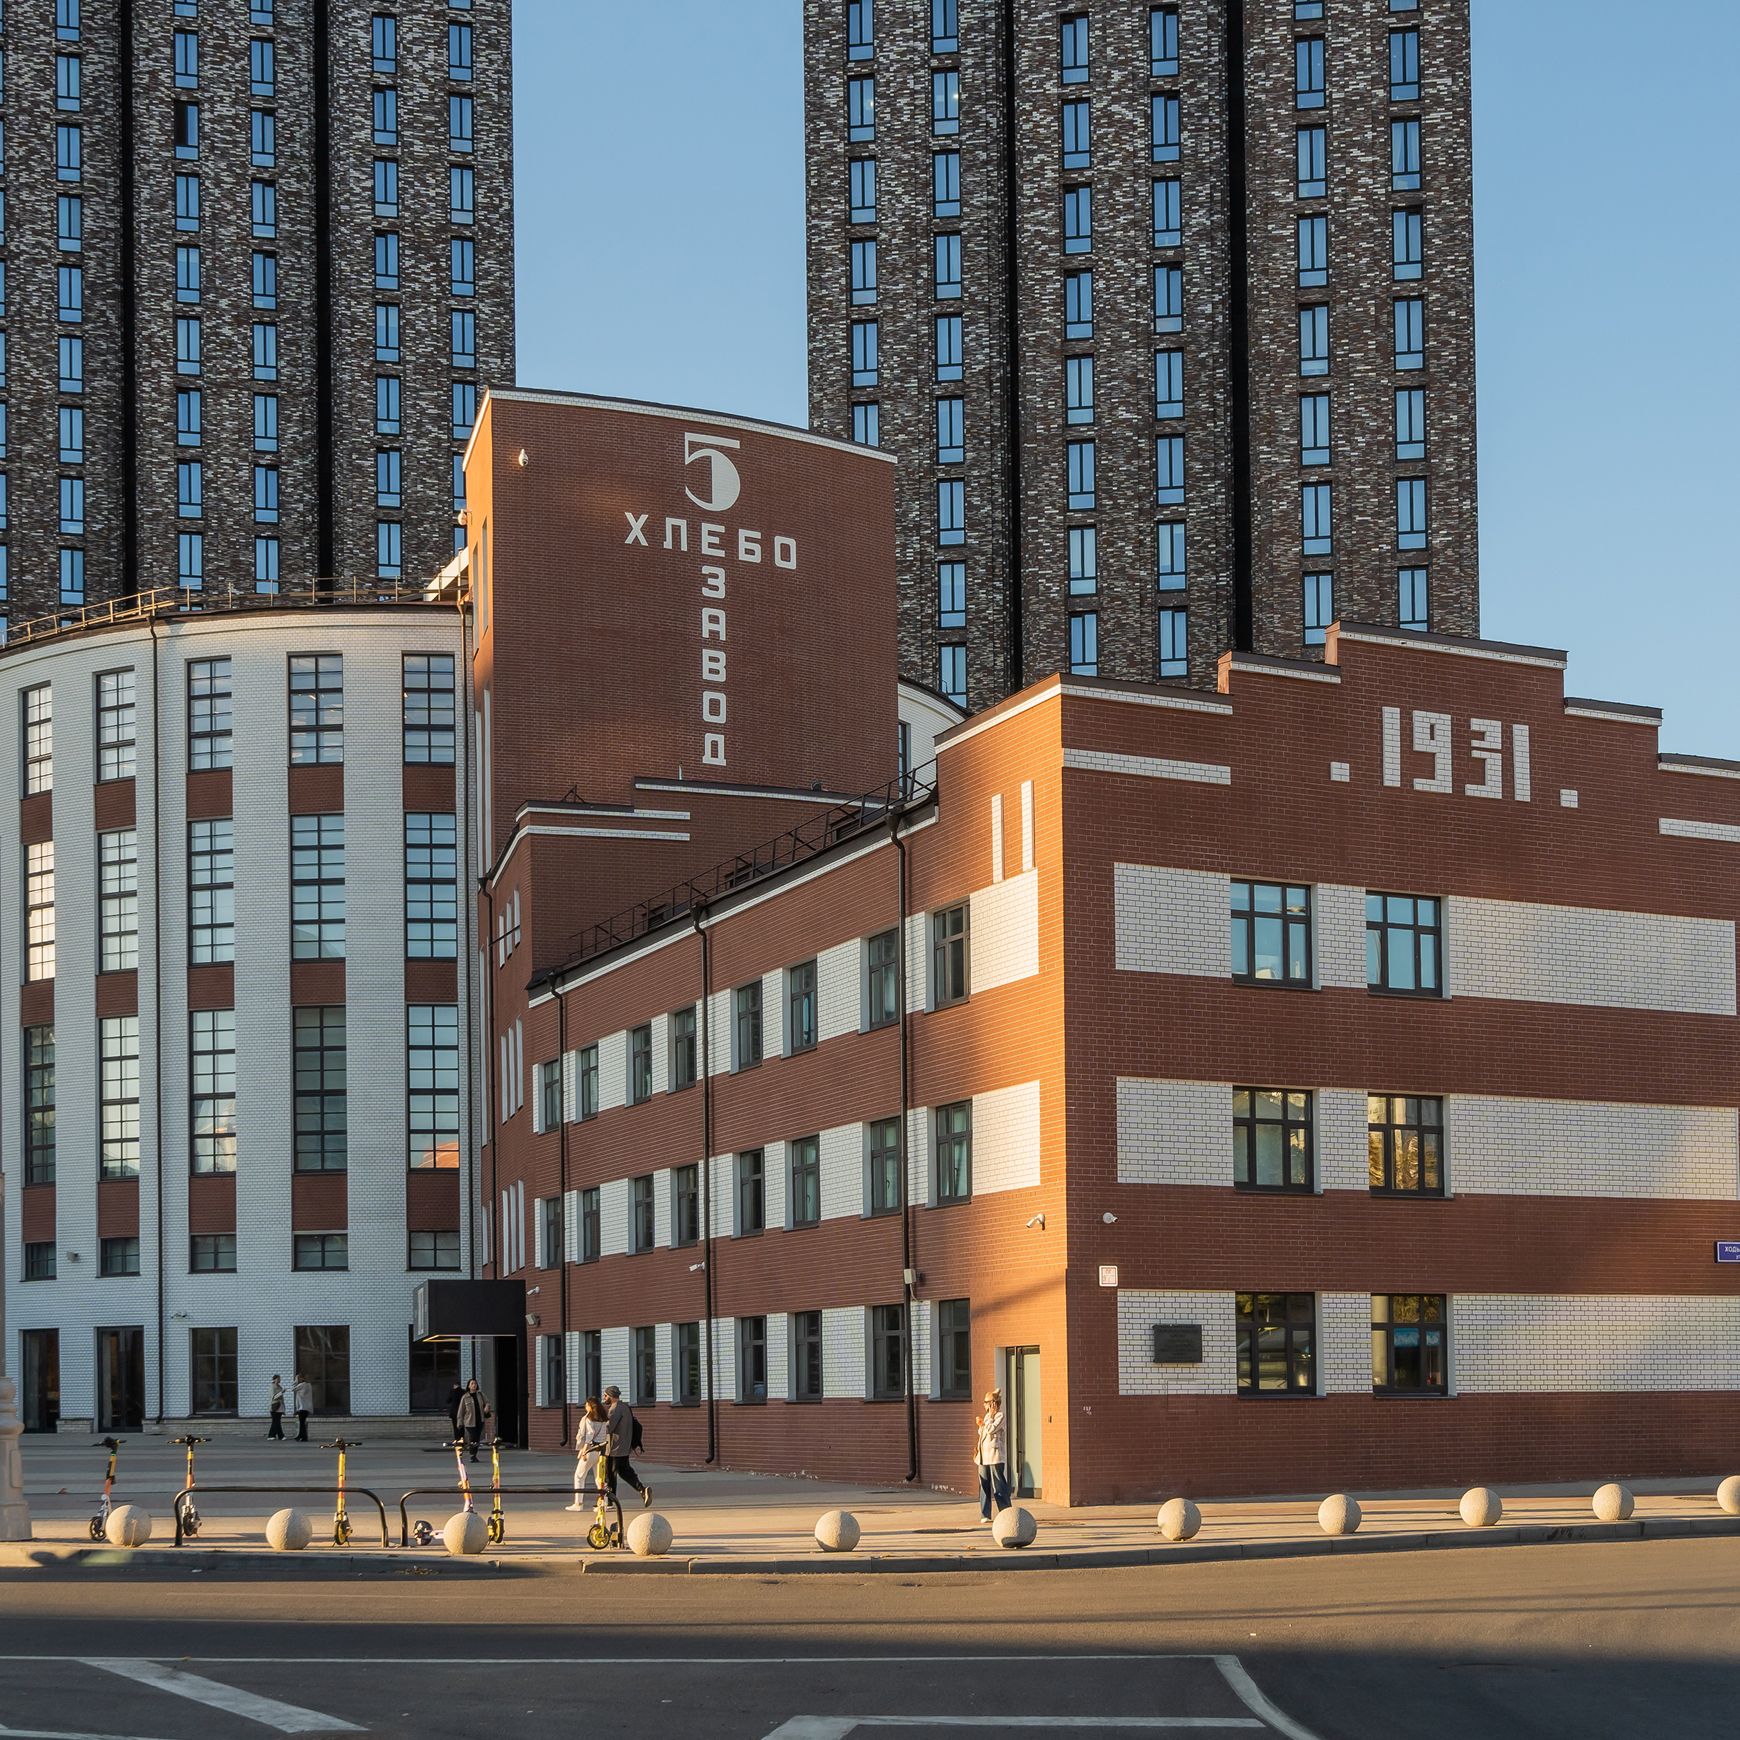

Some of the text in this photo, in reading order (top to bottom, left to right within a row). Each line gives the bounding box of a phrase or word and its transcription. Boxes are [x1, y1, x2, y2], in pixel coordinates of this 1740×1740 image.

[684, 432, 741, 512] 5
[624, 512, 797, 570] ХЛЕБО
[701, 565, 727, 766] ЗАВОД
